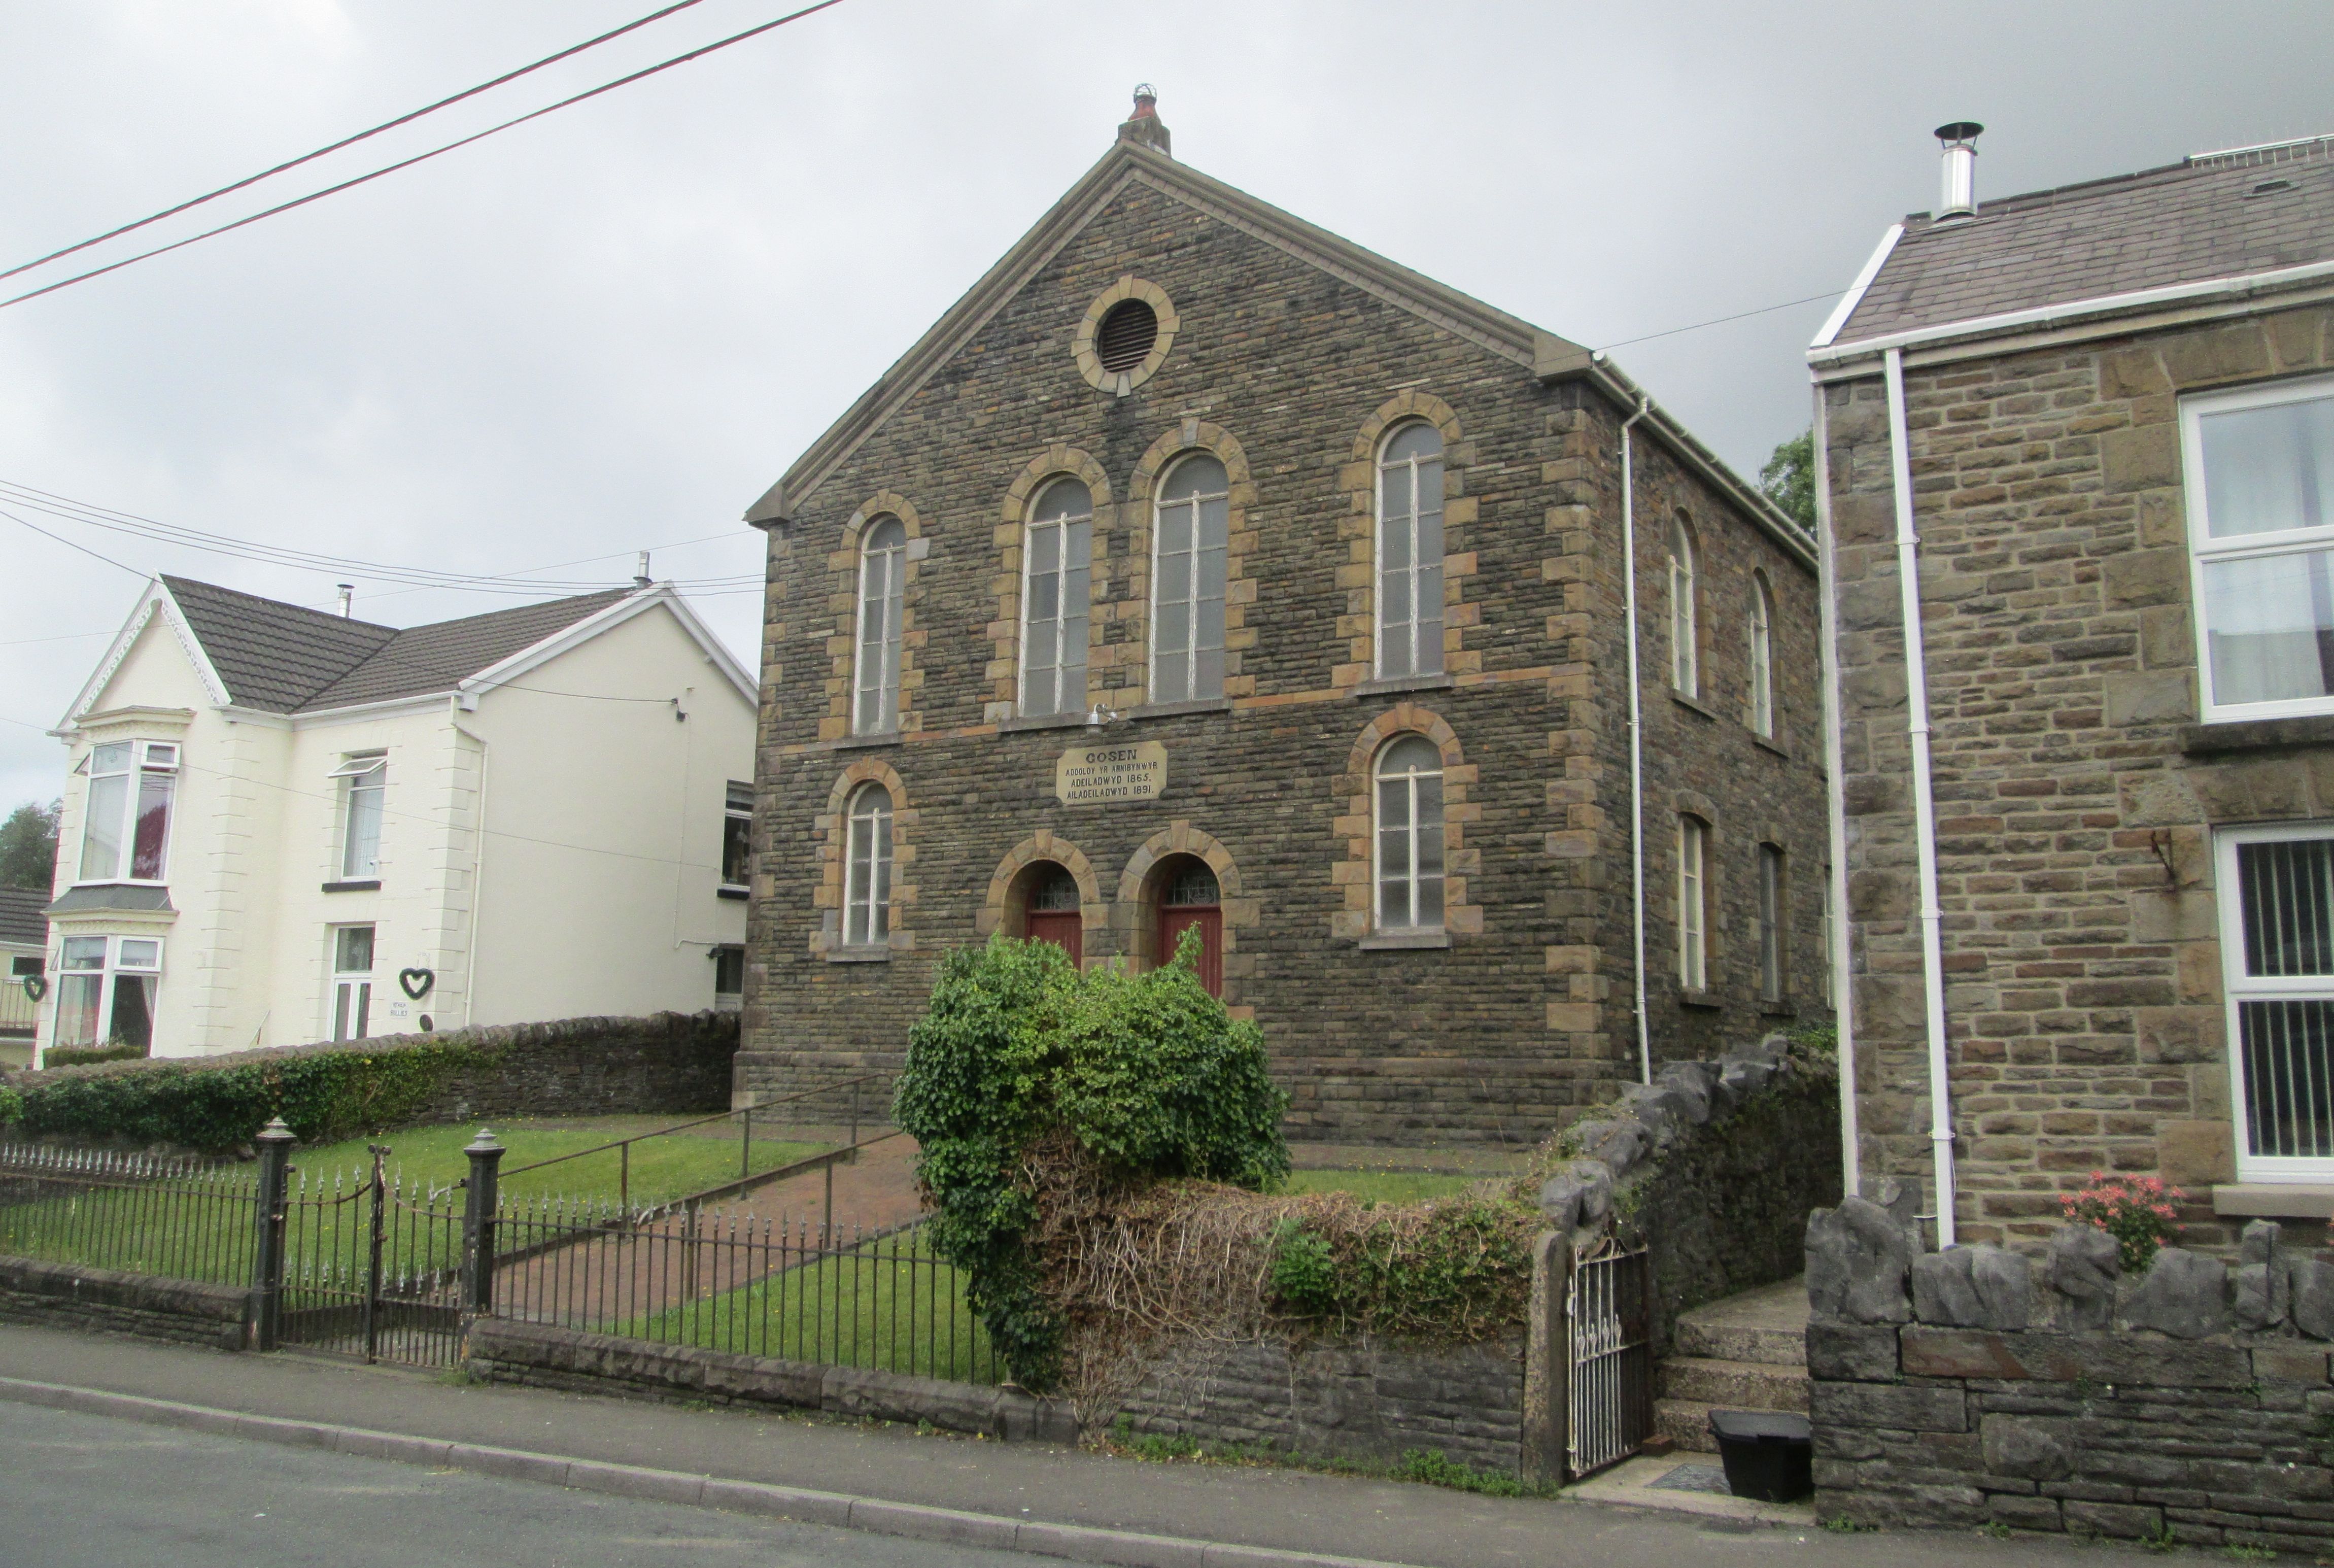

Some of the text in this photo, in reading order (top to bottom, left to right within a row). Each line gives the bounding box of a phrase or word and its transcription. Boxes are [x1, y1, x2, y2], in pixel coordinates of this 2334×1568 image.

[1086, 749, 1137, 763] GOSEN
[1066, 762, 1157, 776] ADDOLDY YR ANNIBYNWYR
[1071, 773, 1151, 787] ADEILADWYD 1865.
[1067, 785, 1153, 799] AILADEILADWYD 1891.
